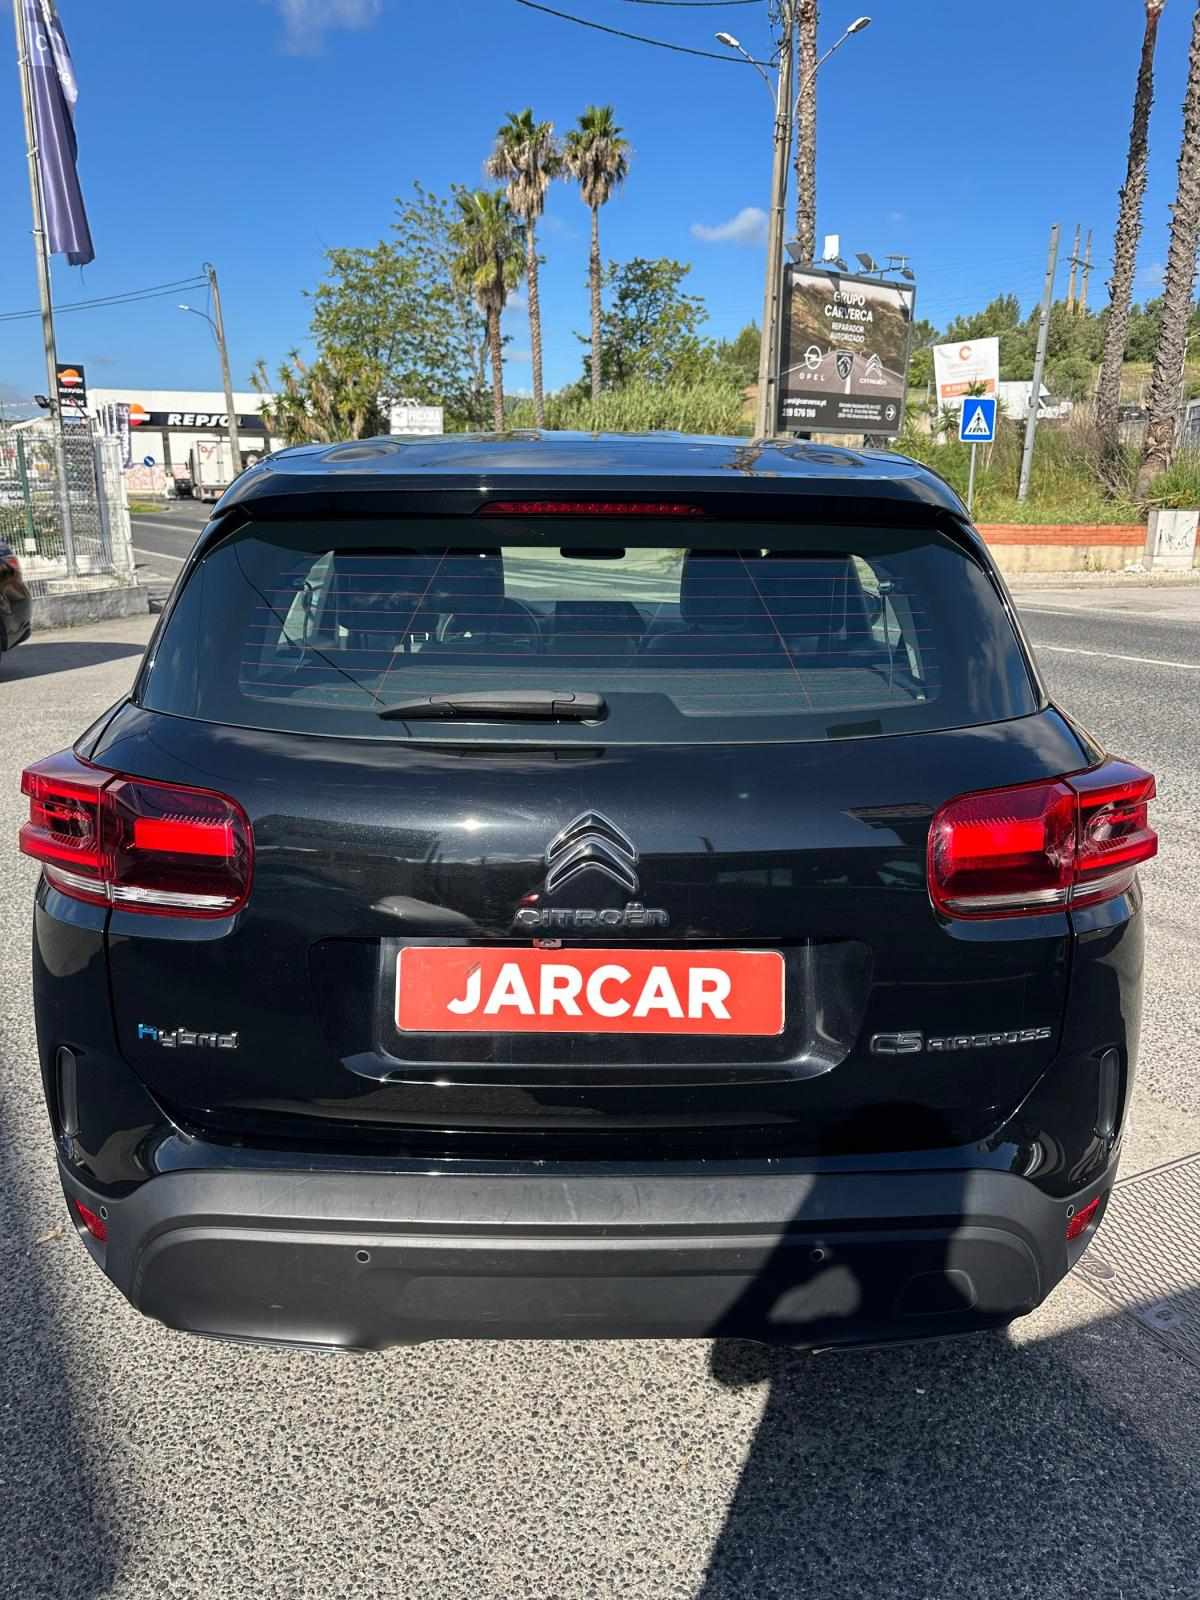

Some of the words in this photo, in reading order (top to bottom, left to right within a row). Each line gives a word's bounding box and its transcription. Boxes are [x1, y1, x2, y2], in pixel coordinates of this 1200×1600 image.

[833, 291, 865, 306] GRUPO
[824, 304, 873, 322] CARVERCA
[799, 372, 825, 382] OPEL
[168, 413, 242, 427] REPSO
[447, 962, 732, 1020] JARCAR
[870, 1031, 923, 1054] C5
[927, 1026, 1052, 1052] AIRCROSS
